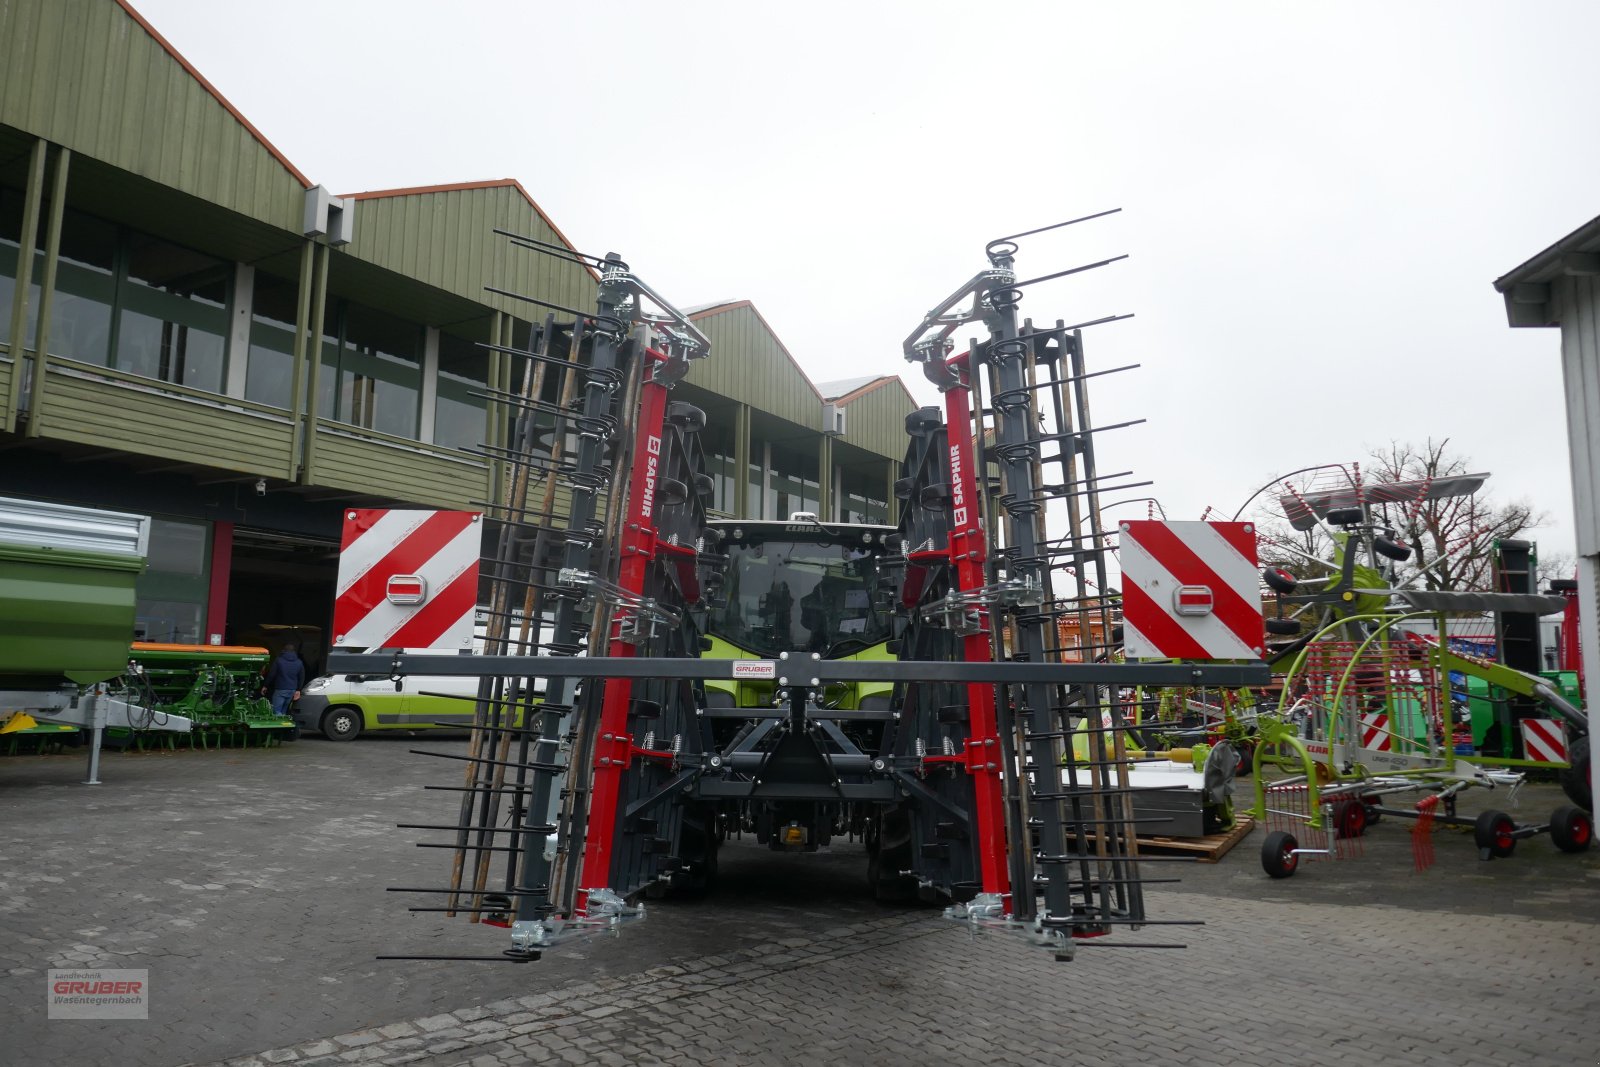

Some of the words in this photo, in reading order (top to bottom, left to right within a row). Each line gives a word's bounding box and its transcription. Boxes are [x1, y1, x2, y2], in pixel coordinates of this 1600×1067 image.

[641, 456, 657, 518] SAPHIR
[950, 444, 964, 506] SAPHIR
[785, 525, 821, 533] CLAAS
[1306, 745, 1329, 755] CLAA
